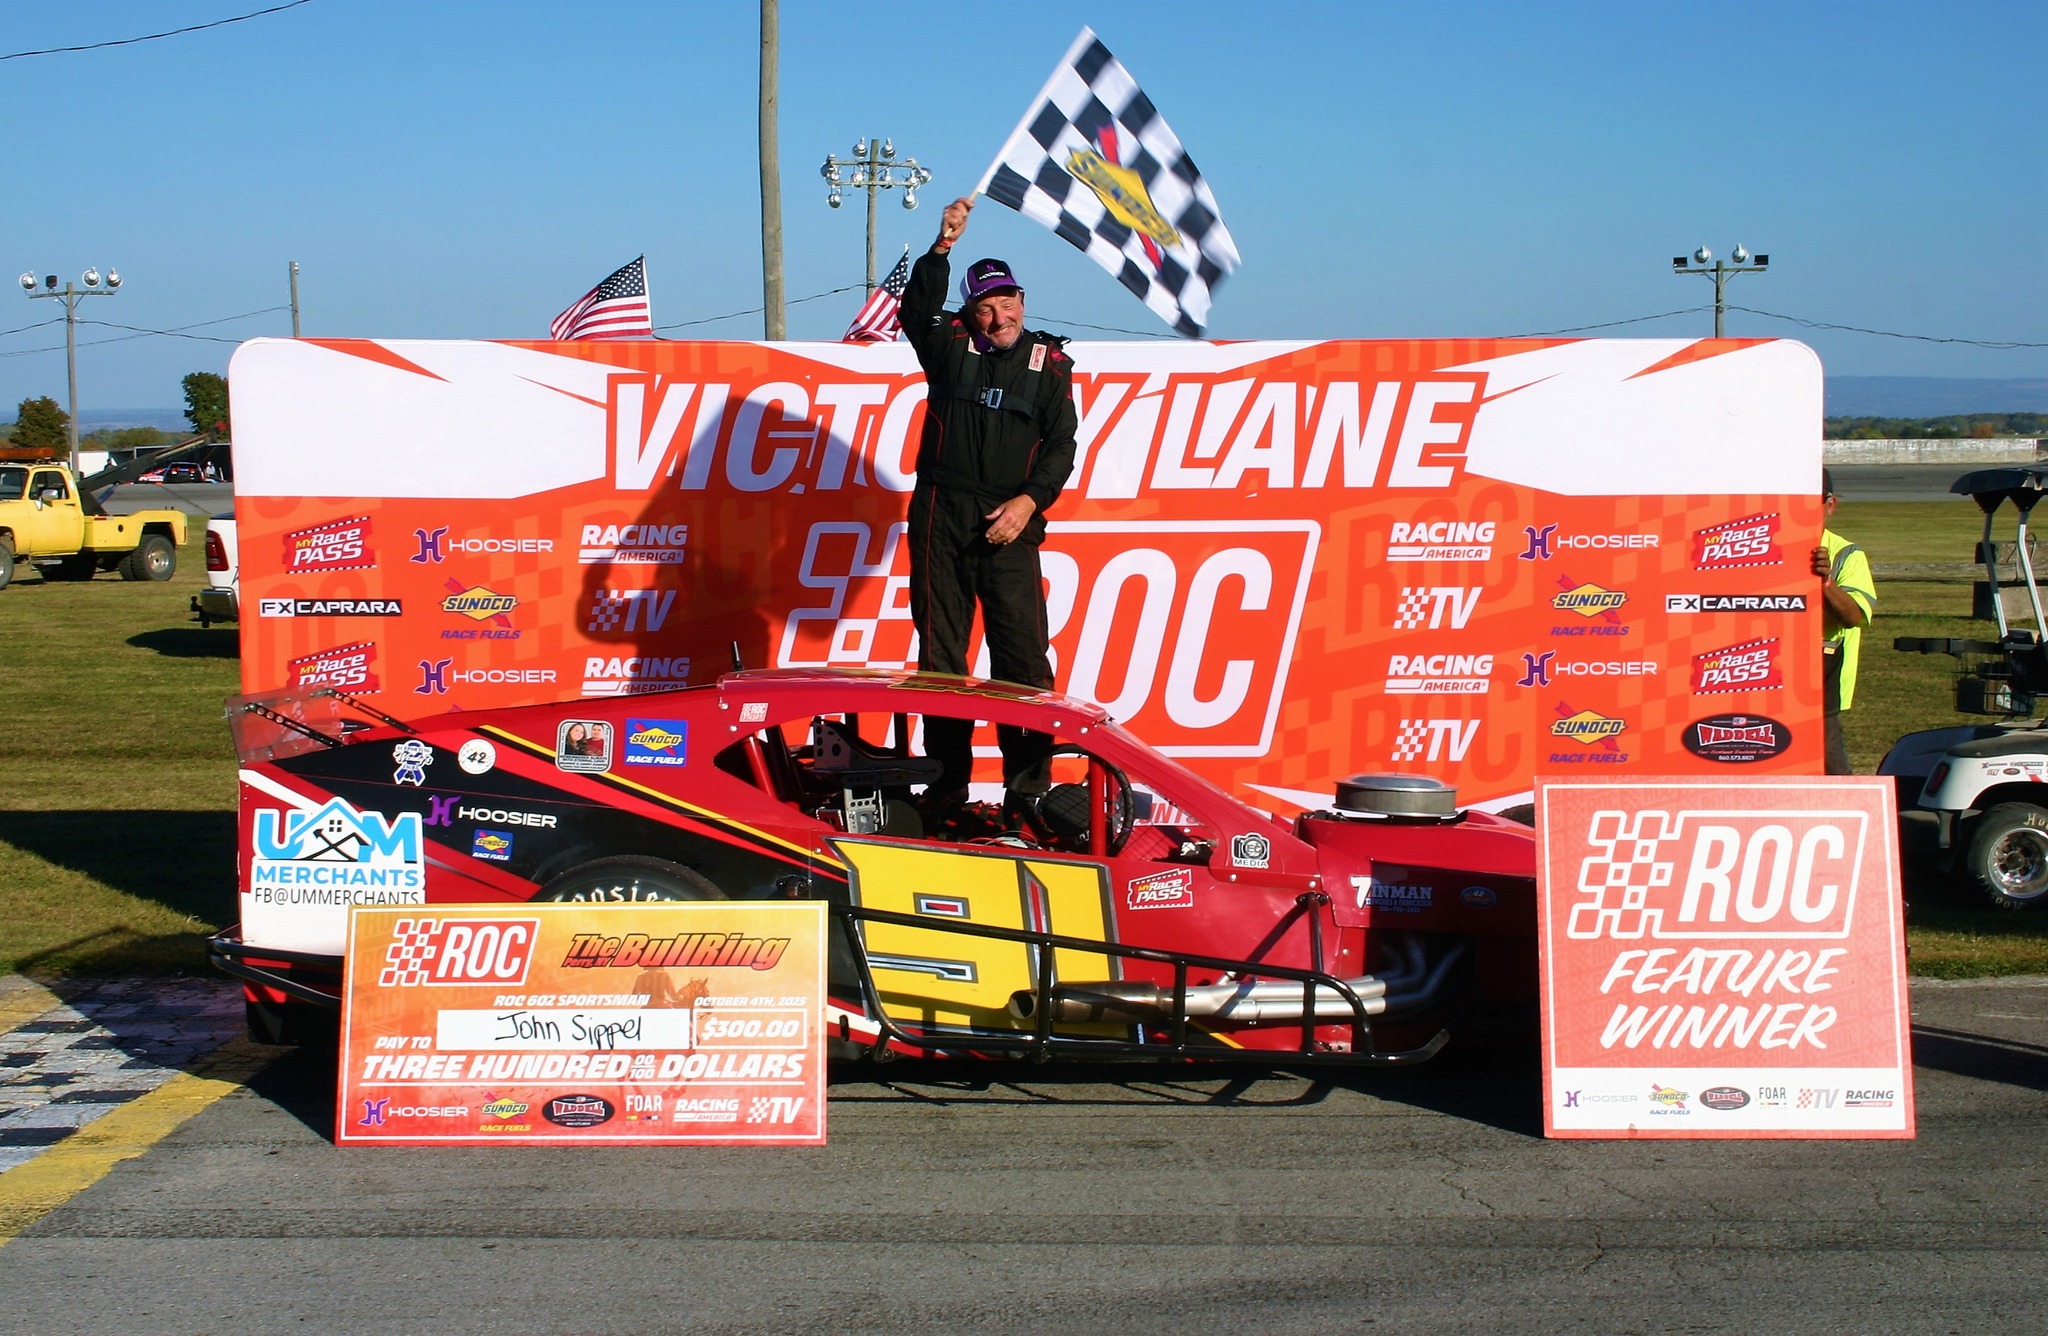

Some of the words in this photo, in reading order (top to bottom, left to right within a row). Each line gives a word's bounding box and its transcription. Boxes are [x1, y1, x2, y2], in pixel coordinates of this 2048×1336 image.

[614, 379, 1133, 494] VICTOY
[1150, 381, 1477, 489] LANE
[580, 524, 689, 546] RACING
[1389, 521, 1497, 543] RACING
[449, 538, 554, 553] HOOSIER
[1557, 534, 1659, 549] HOOSIER
[1701, 536, 1771, 563] PASS
[293, 539, 363, 567] PASS
[262, 602, 292, 614] FX
[296, 601, 401, 614] CAPRARA
[445, 597, 515, 610] SUNOCO
[1428, 586, 1484, 629] TV
[1555, 593, 1624, 607] SUNOCO
[1668, 598, 1698, 610] FX
[1702, 597, 1805, 610] CAPRARA
[623, 589, 677, 632] TV
[440, 630, 478, 639] RACE
[480, 630, 521, 639] FUELS
[1550, 626, 1588, 636] RACE
[1589, 626, 1630, 636] FUELS
[584, 657, 691, 678] RACING
[1387, 654, 1495, 676] RACING
[1555, 661, 1658, 675] HOOSIER
[452, 669, 557, 683] HOOSIER
[1700, 660, 1770, 688] PASS
[1554, 721, 1622, 734] SUNOCO
[1697, 723, 1775, 747] WADDELL
[631, 734, 681, 745] SUNOCO
[1426, 719, 1482, 761] TV
[467, 751, 487, 764] 42
[626, 755, 653, 764] RACE
[654, 756, 685, 765] FUELS
[1549, 753, 1585, 763] RACE
[1588, 753, 1629, 763] FUELS
[458, 806, 558, 829] HOOSIER
[1233, 859, 1268, 868] MEDIA
[255, 865, 419, 887] MERCHANTS
[1678, 825, 1846, 923] ROC
[254, 887, 419, 906] FB@UMMERCHANTS
[1136, 887, 1185, 904] PASS
[437, 925, 527, 979] ROC
[568, 934, 621, 957] The
[611, 932, 791, 971] BullRing
[1600, 946, 1848, 998] FEATURE
[493, 994, 526, 1007] ROC
[527, 994, 554, 1006] 602
[556, 994, 651, 1006] SPORTSMAN
[694, 996, 749, 1007] OCTOBER
[749, 997, 776, 1008] 4TH,
[775, 997, 807, 1006] 2025
[494, 1011, 561, 1043] John
[702, 1016, 800, 1041] $300.00
[1600, 1003, 1838, 1050] WINNER
[375, 1036, 408, 1049] PAY
[410, 1036, 432, 1049] TO
[361, 1054, 473, 1080] THREE
[477, 1054, 632, 1080] HUNDRED
[634, 1054, 656, 1065] 00
[657, 1053, 806, 1079] DOLLARS
[629, 1068, 655, 1080] 100
[1582, 1095, 1639, 1103] HOOSIER
[1651, 1093, 1687, 1101] SUNOCO
[1758, 1086, 1787, 1100] FOAR
[1813, 1088, 1840, 1109] TV
[1845, 1090, 1894, 1100] RACING
[388, 1106, 469, 1117] HOOSIER
[483, 1104, 527, 1113] SUNOCO
[553, 1100, 605, 1117] WADDELL
[626, 1094, 663, 1112] FOAR
[675, 1098, 740, 1112] RACING
[769, 1096, 805, 1124] TV
[504, 1124, 532, 1132] FUELS
